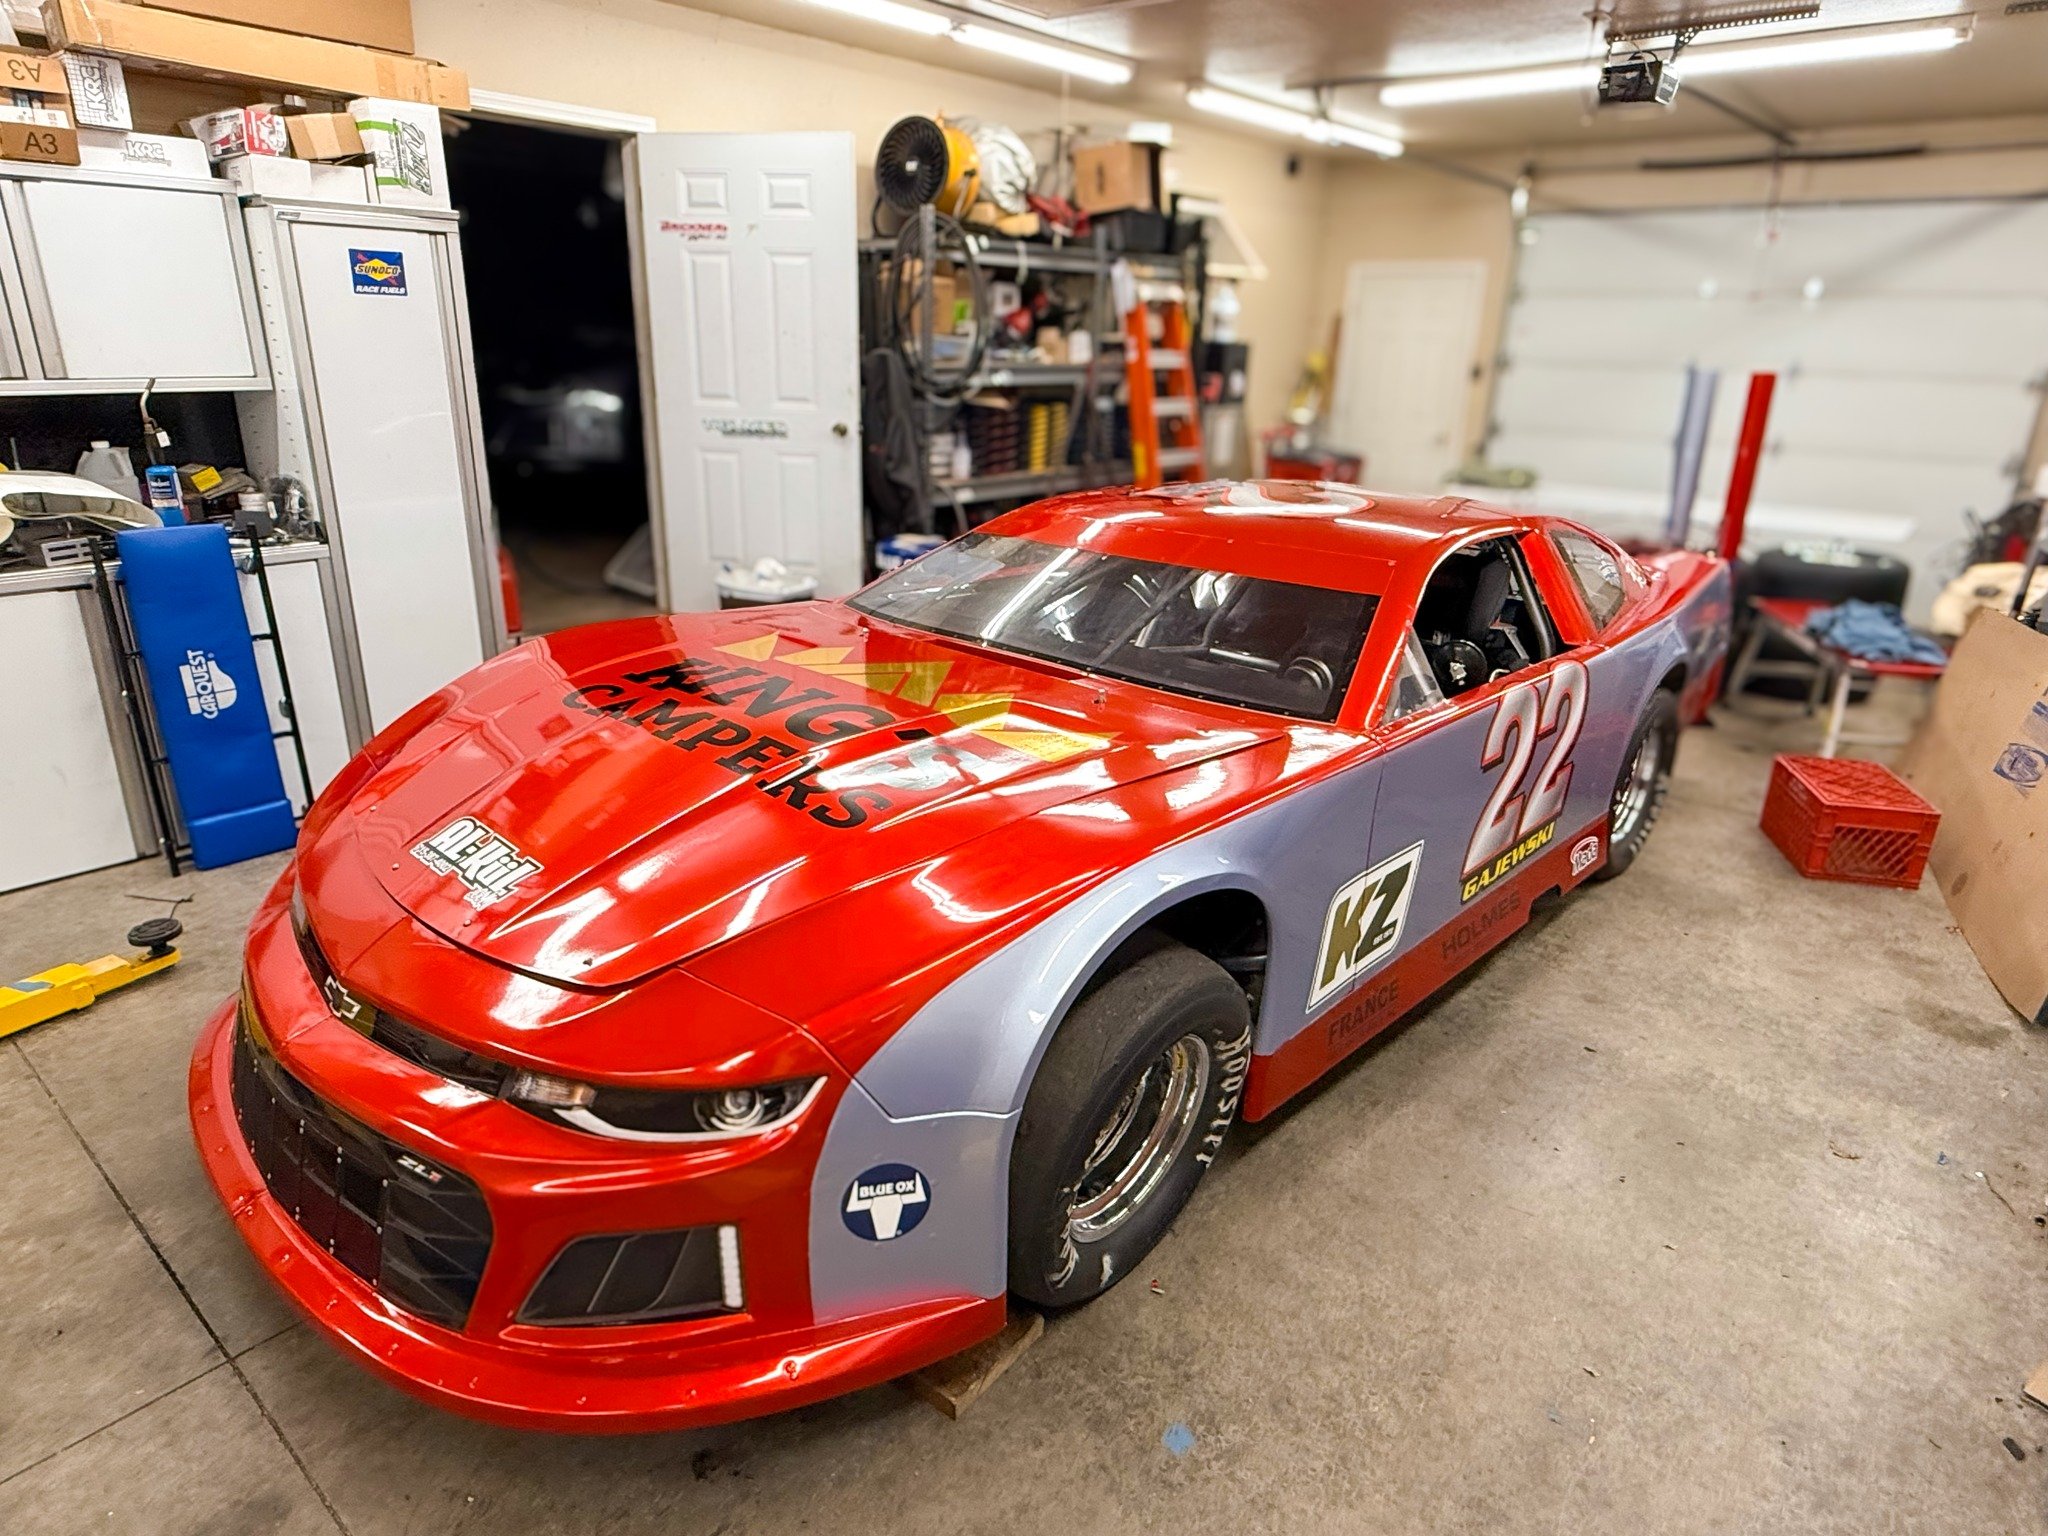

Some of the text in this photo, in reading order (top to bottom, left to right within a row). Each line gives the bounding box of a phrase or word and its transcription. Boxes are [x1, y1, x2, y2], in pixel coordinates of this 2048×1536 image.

[7, 59, 42, 83] A3
[79, 63, 110, 112] KRC
[24, 131, 59, 155] A3
[124, 139, 165, 160] KRC
[355, 284, 406, 295] RACE FUELS
[356, 264, 400, 276] SUNOCO
[186, 649, 219, 720] CARQUEST
[562, 683, 894, 829] CAMPERS
[1461, 659, 1590, 882] 22
[1461, 820, 1555, 902] GAJEWSKI
[1319, 860, 1413, 991] KZ
[1440, 889, 1521, 960] HOLMES
[1327, 978, 1399, 1046] FRANCE
[859, 1180, 915, 1199] BLUE OX
